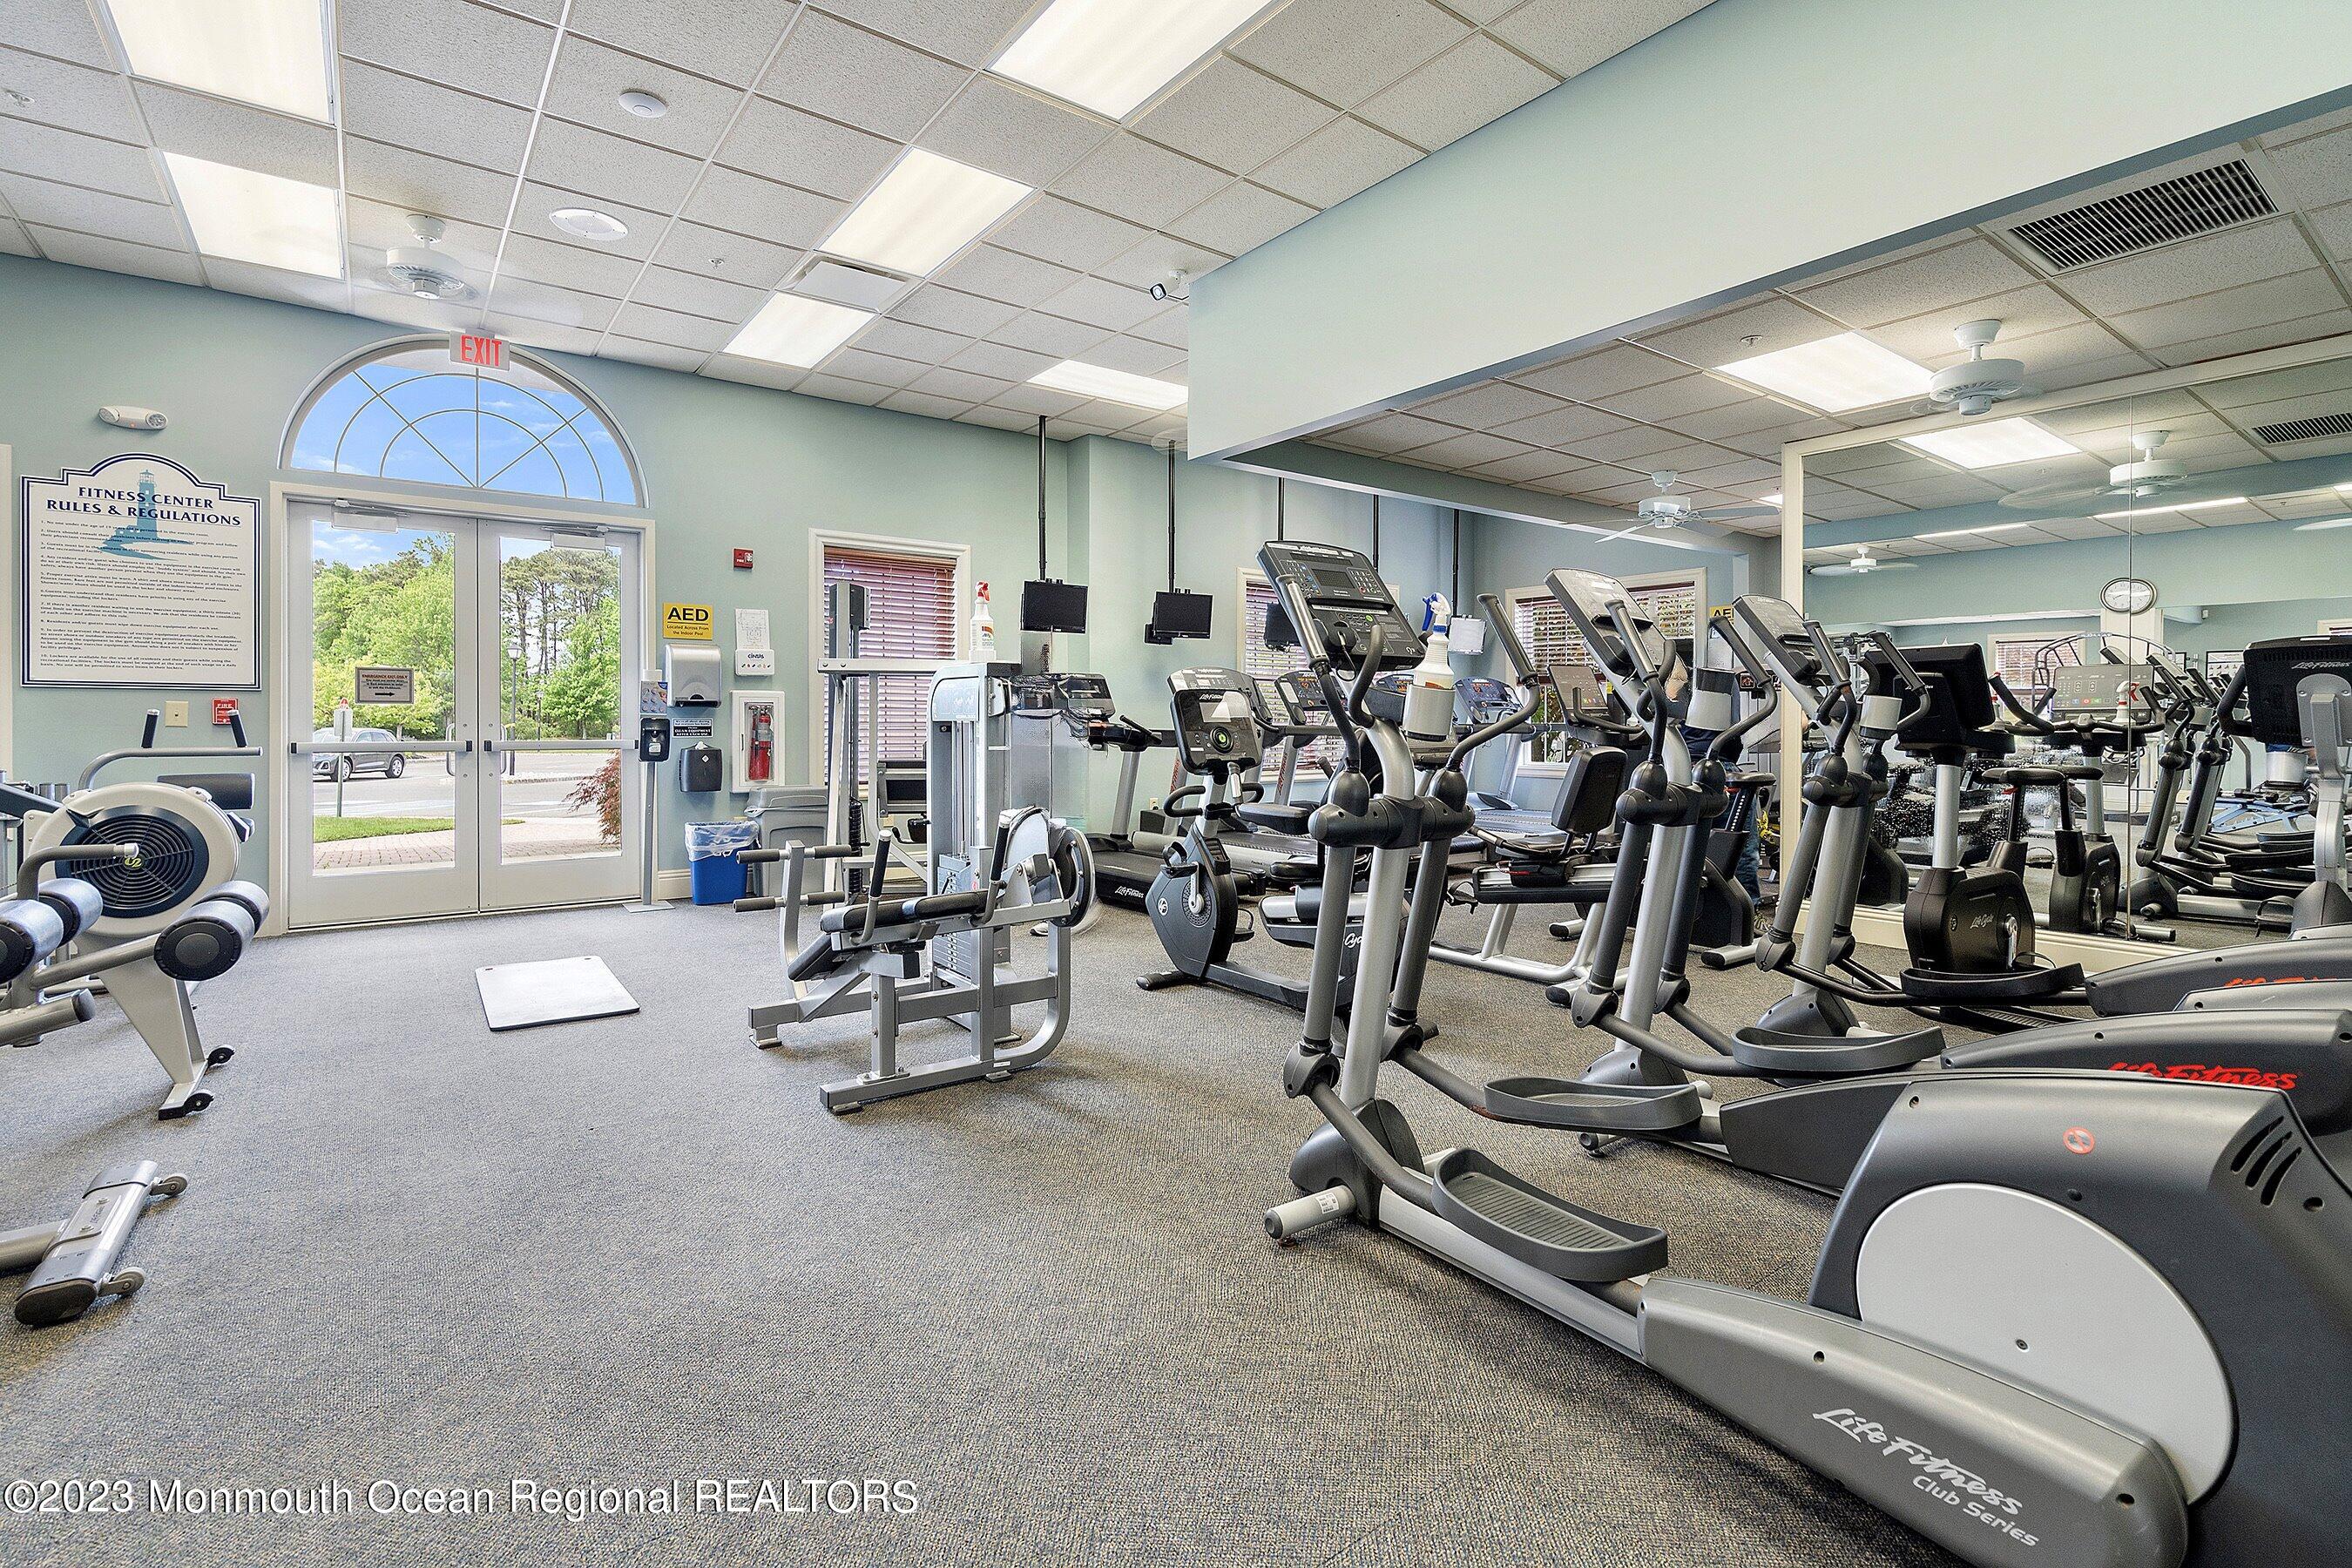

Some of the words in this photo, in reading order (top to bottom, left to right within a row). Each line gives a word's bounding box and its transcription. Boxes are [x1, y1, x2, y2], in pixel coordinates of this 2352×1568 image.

[460, 334, 503, 367] EXIT
[78, 486, 146, 503] FITNESS
[152, 493, 213, 509] CENTER
[47, 499, 102, 514] RULES
[107, 504, 122, 516] &
[127, 506, 241, 526] REGULATIONS
[667, 606, 709, 622] AED
[1713, 608, 1734, 618] AE
[1912, 1475, 1960, 1505] Club
[1963, 1500, 2039, 1547] Series
